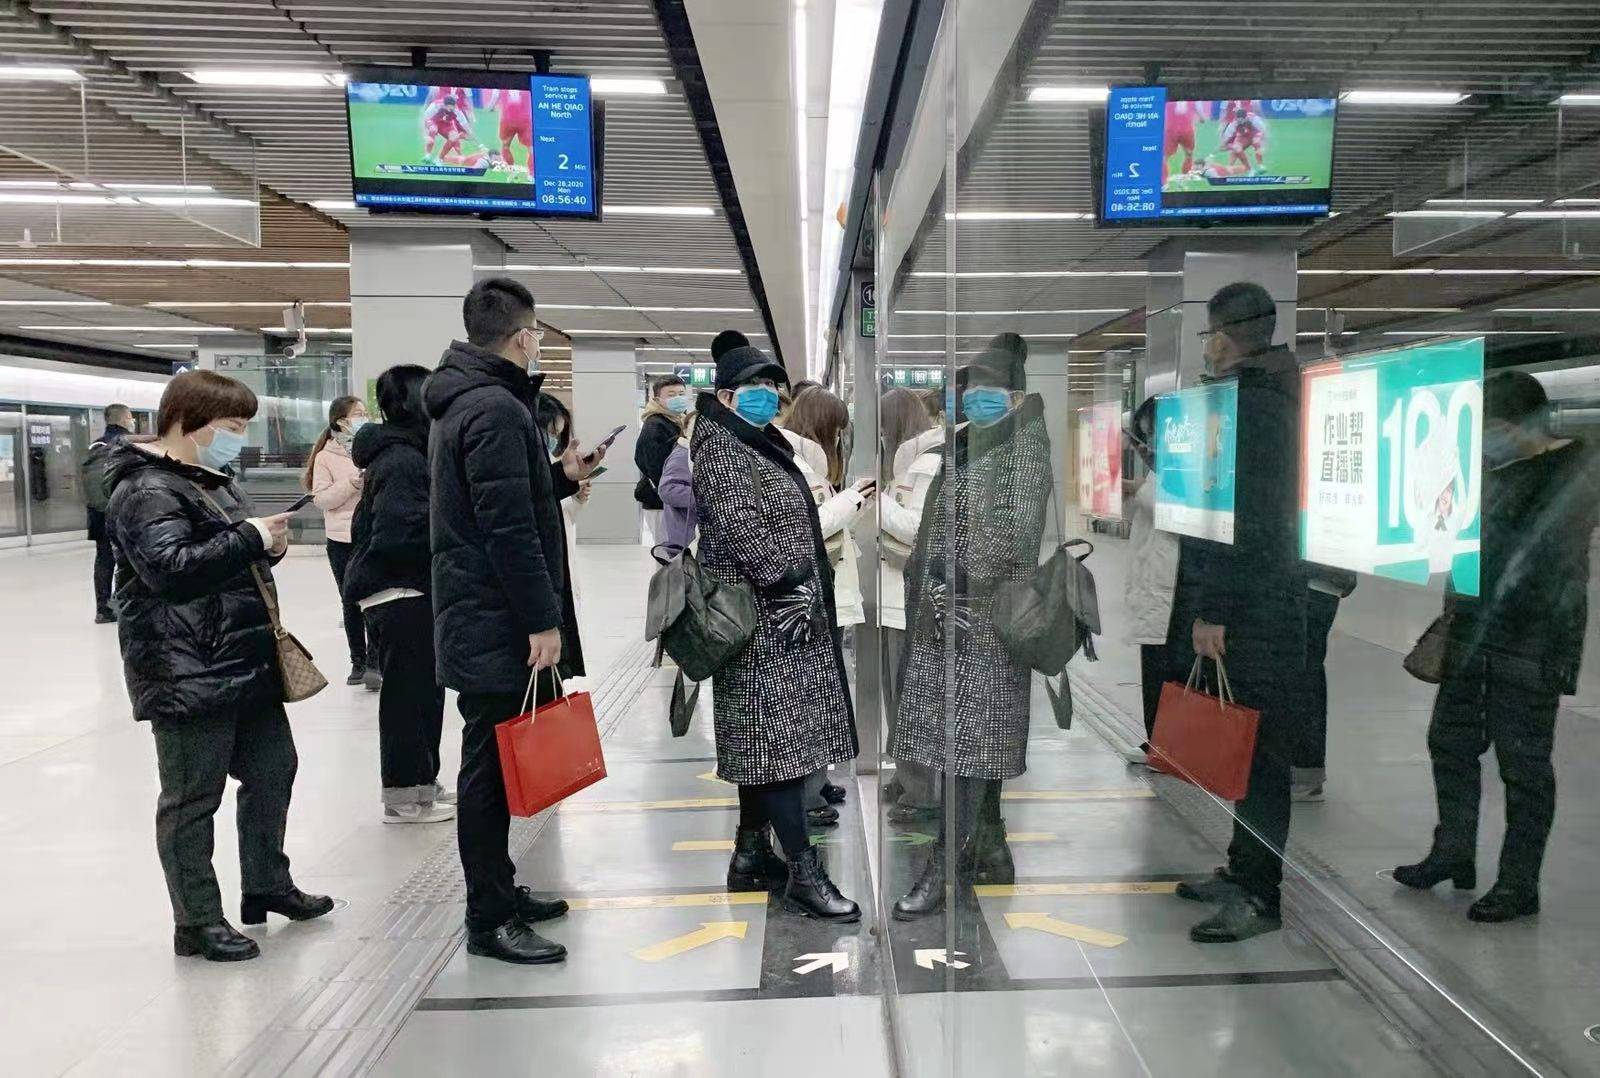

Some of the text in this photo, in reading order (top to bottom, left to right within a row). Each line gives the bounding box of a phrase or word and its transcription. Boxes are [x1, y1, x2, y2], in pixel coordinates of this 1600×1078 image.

[542, 84, 578, 94] Train stops
[538, 102, 584, 111] AN HE QIAO
[550, 110, 572, 119] North
[539, 135, 555, 143] Next
[558, 153, 569, 170] 2
[541, 194, 587, 205] 08:56:40
[1323, 411, 1363, 446] 作业帮
[1320, 449, 1364, 485] 直播课
